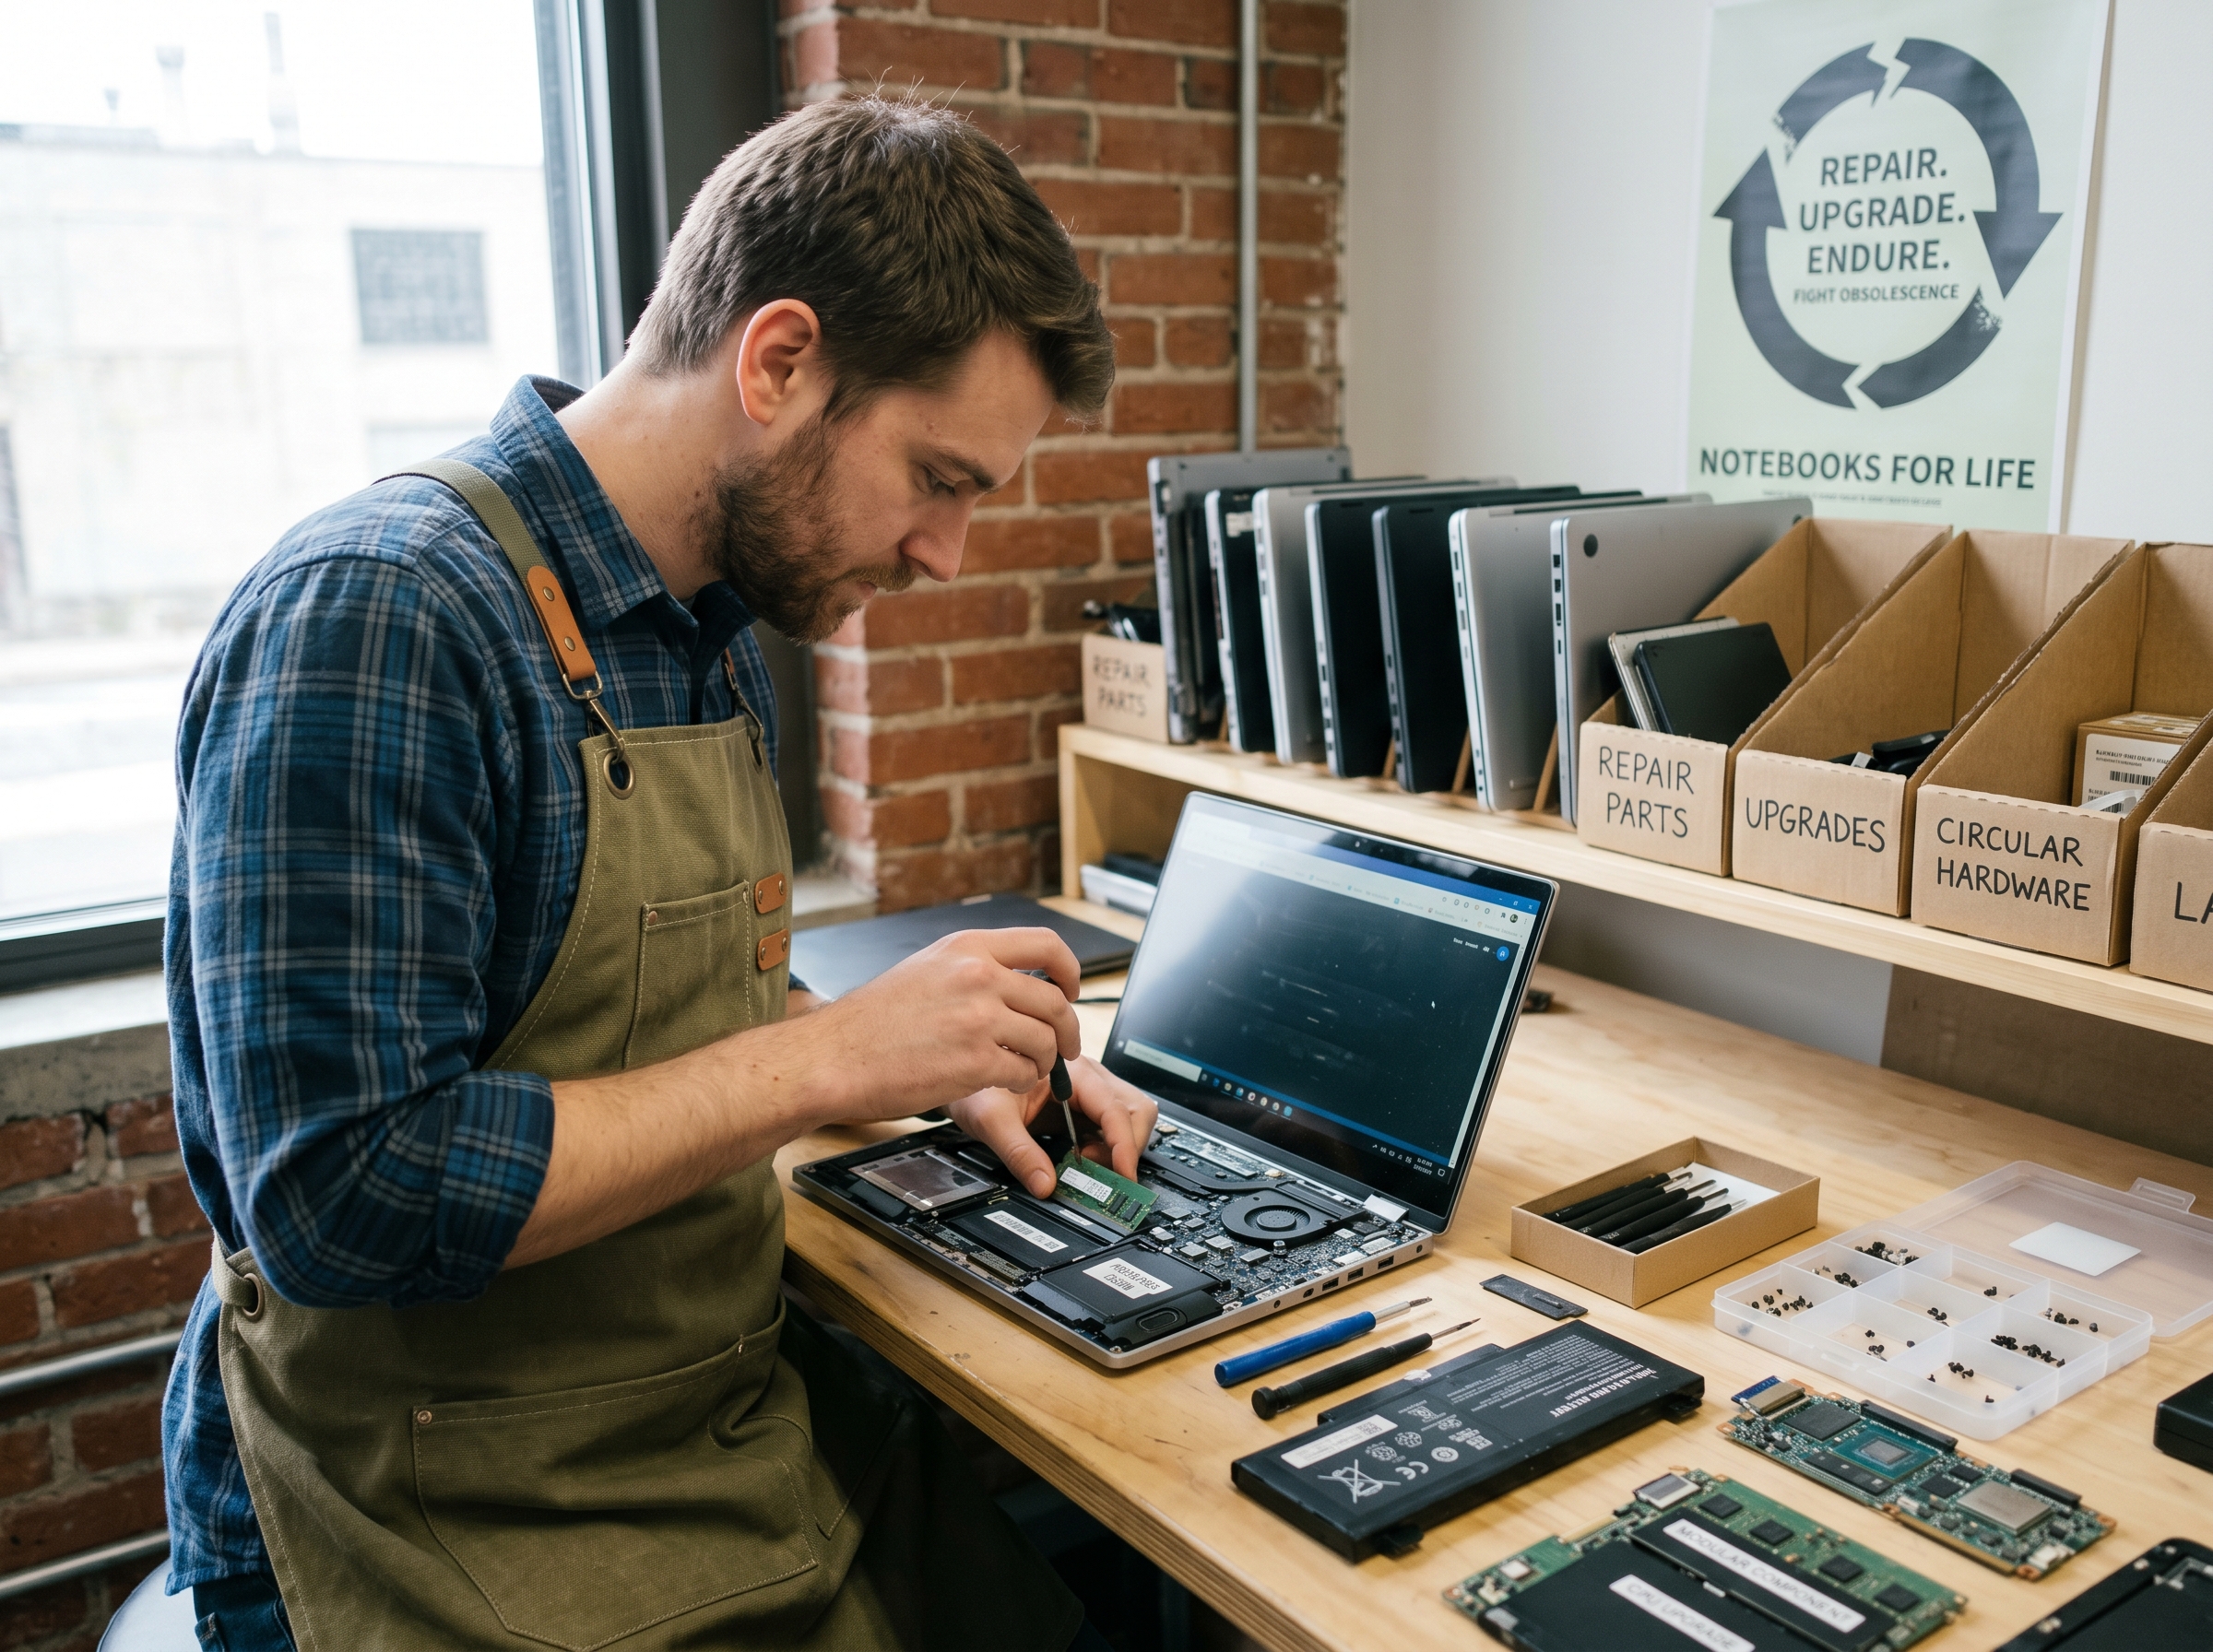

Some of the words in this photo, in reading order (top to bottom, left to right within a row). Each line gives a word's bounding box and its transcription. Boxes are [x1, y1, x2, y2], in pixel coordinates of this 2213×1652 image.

[1820, 148, 1948, 187] REPAIR.
[1799, 192, 1966, 231] UPGRADE.
[1807, 239, 1950, 275] ENDURE.
[1793, 287, 1836, 304] FIGHT
[1839, 283, 1959, 302] OBSOLESCENCE
[1699, 448, 1882, 483] NOTEBOOKS
[1890, 454, 1956, 486] FOR
[1965, 457, 2036, 490] LIFE
[1093, 654, 1151, 689] REPAIR
[1097, 686, 1146, 717] PARTS
[1598, 746, 1695, 796] REPAIR
[1606, 791, 1689, 839] PARTS
[1746, 796, 1887, 854] UPGRADES
[1936, 817, 2084, 867] CIRCULAR
[1936, 856, 2091, 913] HARDWARE
